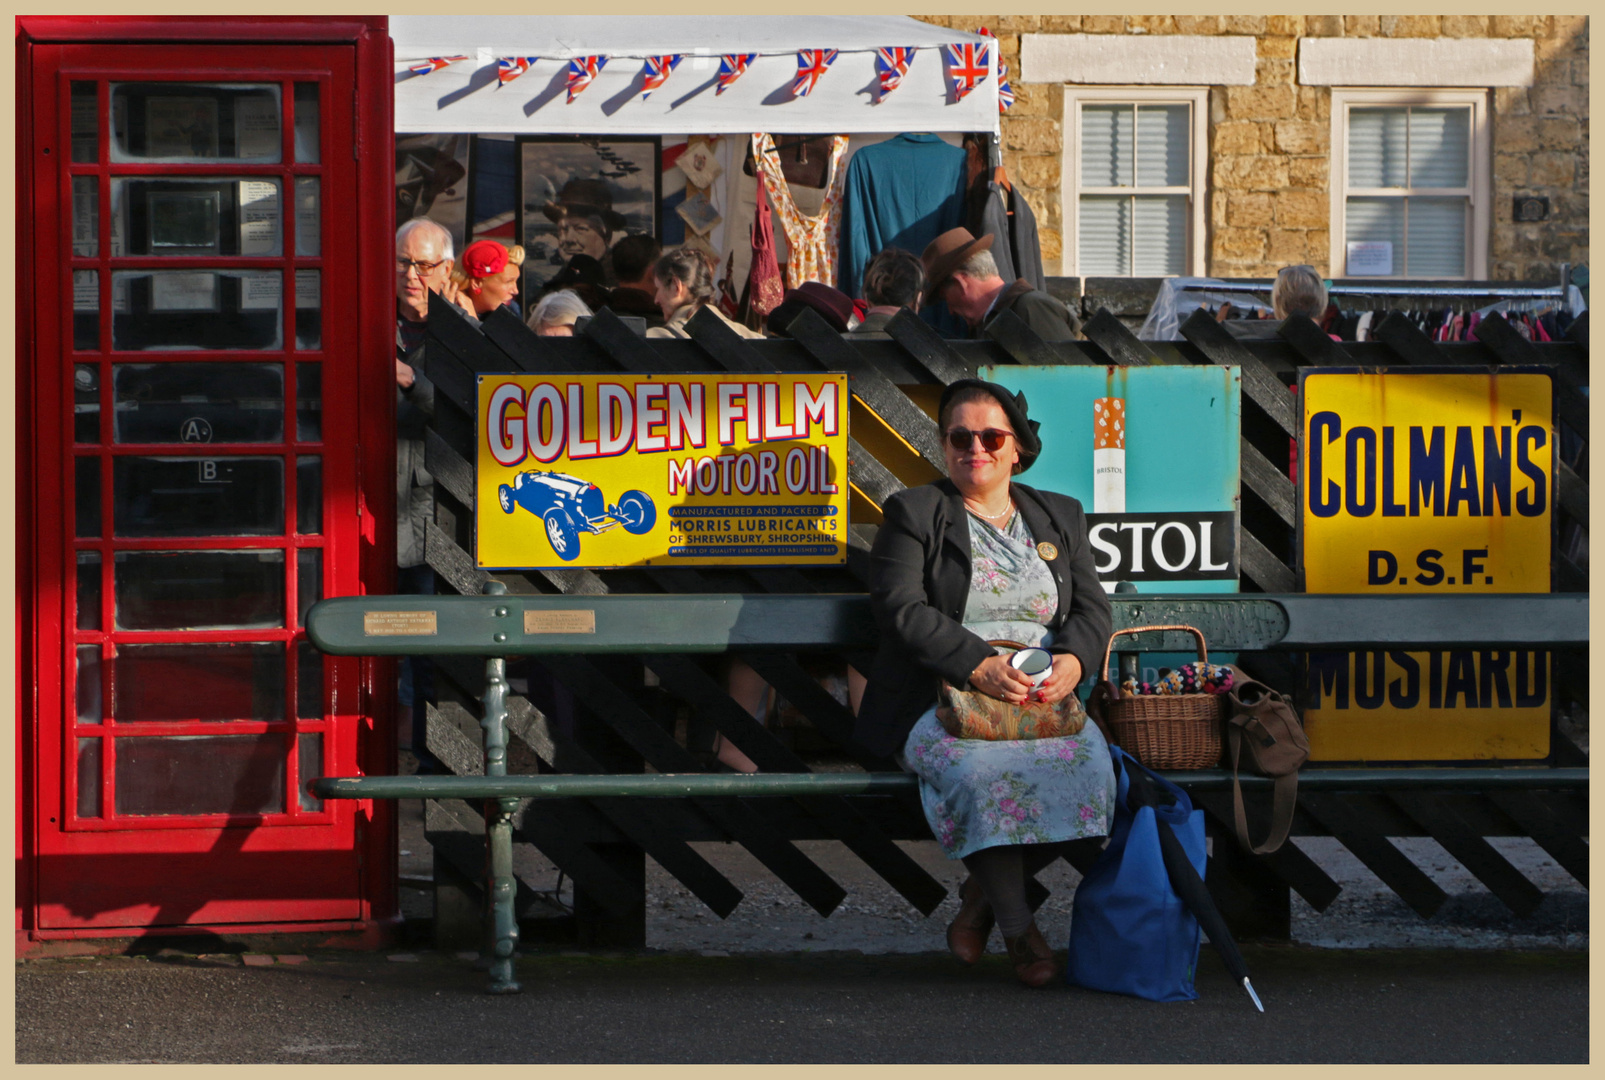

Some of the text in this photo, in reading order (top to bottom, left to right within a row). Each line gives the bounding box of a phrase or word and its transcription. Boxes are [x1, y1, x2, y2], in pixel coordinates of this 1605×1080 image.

[486, 381, 840, 466] GOLDEN FILM
[668, 445, 839, 496] MOTOR OIL
[1096, 467, 1123, 475] BRISTOL
[1308, 408, 1547, 518] COLMAN'S
[669, 519, 838, 532] MORRIS LUBRICANTS
[672, 506, 834, 516] MANUFACTURED AND PACKED BY
[668, 533, 838, 545] OF SHREWSBURY, SHROPSHIRE
[1087, 520, 1229, 574] STOL
[1367, 548, 1495, 587] D.S.F.
